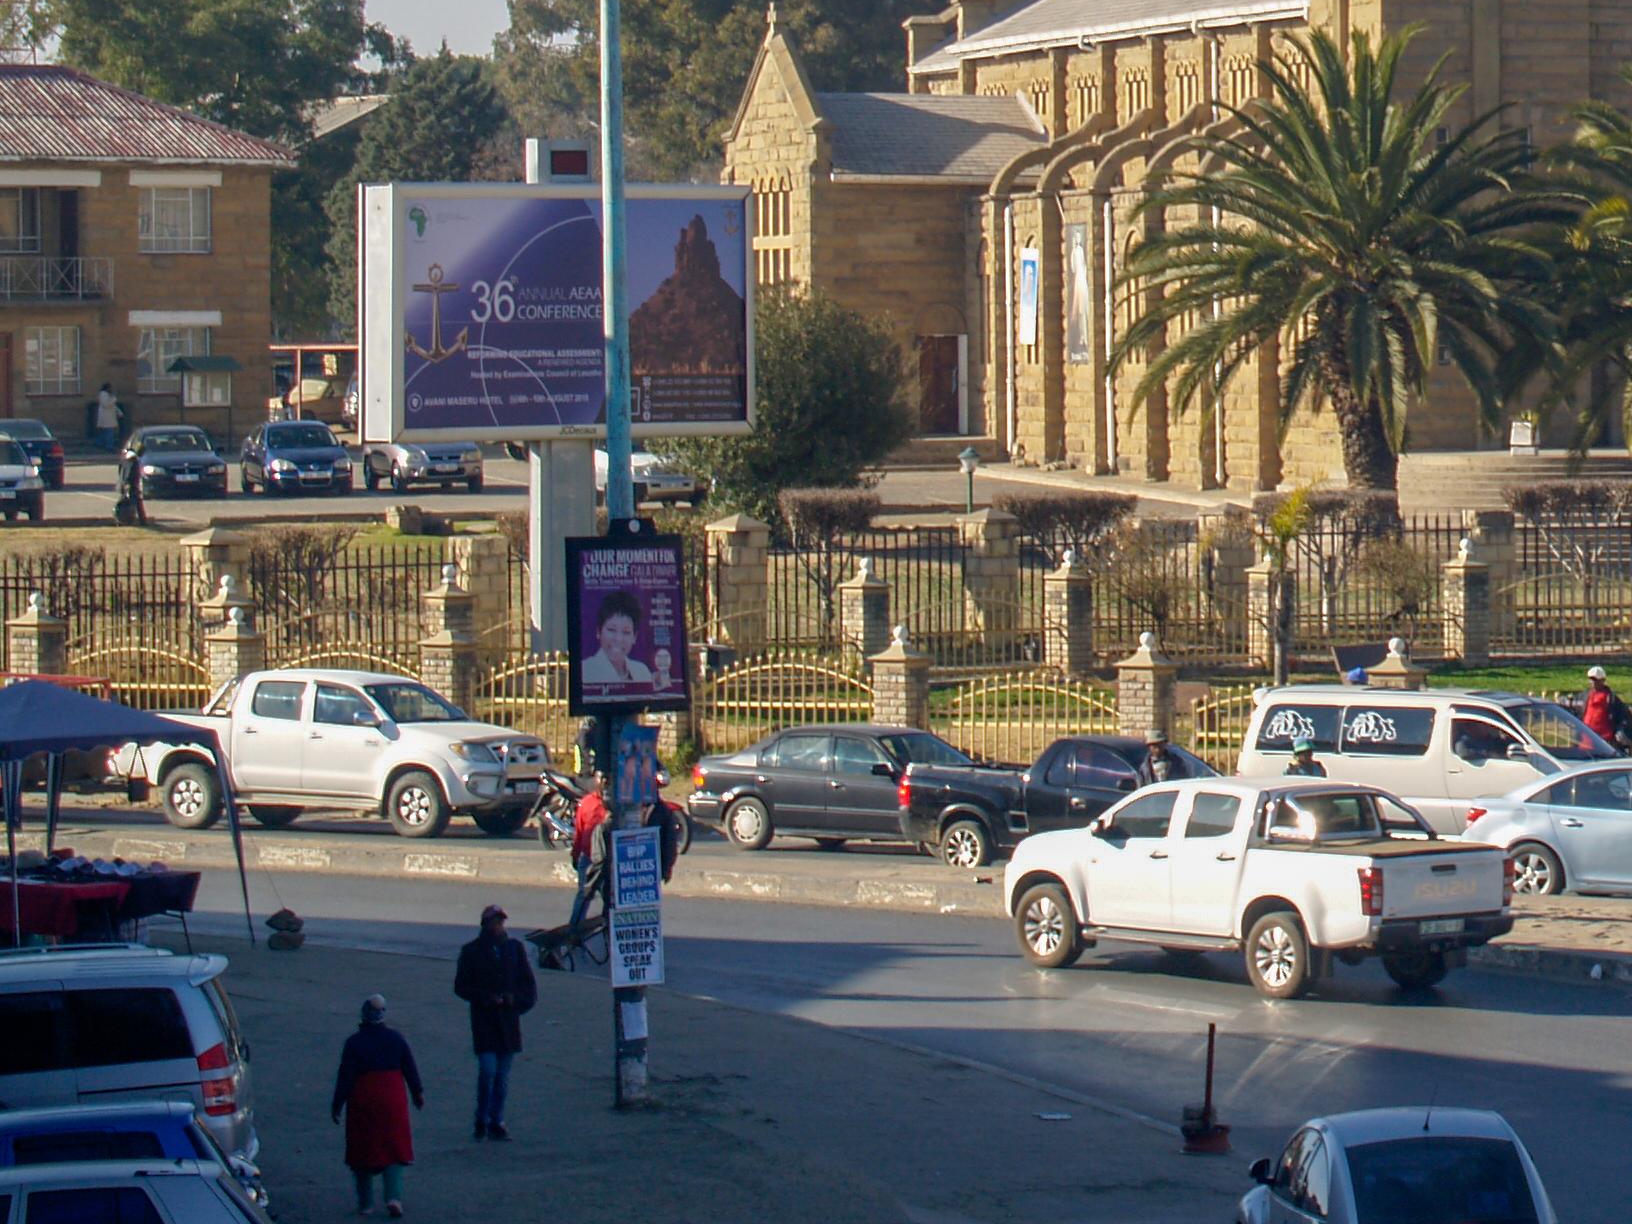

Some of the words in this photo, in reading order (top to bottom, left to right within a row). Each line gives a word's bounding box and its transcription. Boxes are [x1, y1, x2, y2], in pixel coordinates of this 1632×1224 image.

[518, 287, 567, 300] ANNUAL
[569, 286, 602, 299] AEAA
[517, 304, 602, 319] CONFERENCE
[509, 349, 555, 359] EDUCATIONAL
[424, 396, 446, 407] AVANI
[447, 395, 478, 406] MASERU
[480, 395, 503, 406] HOTEL
[583, 563, 630, 577] CHANGE
[631, 563, 651, 576] GALA
[619, 858, 656, 873] RALLIES
[620, 874, 655, 889] BEHIND
[1413, 879, 1477, 898] ISUZU
[621, 889, 657, 904] LEADER
[616, 926, 659, 941] WOMEN'S
[619, 941, 656, 955] GROUPS
[624, 954, 652, 967] SPEAK
[629, 967, 647, 980] OUT
